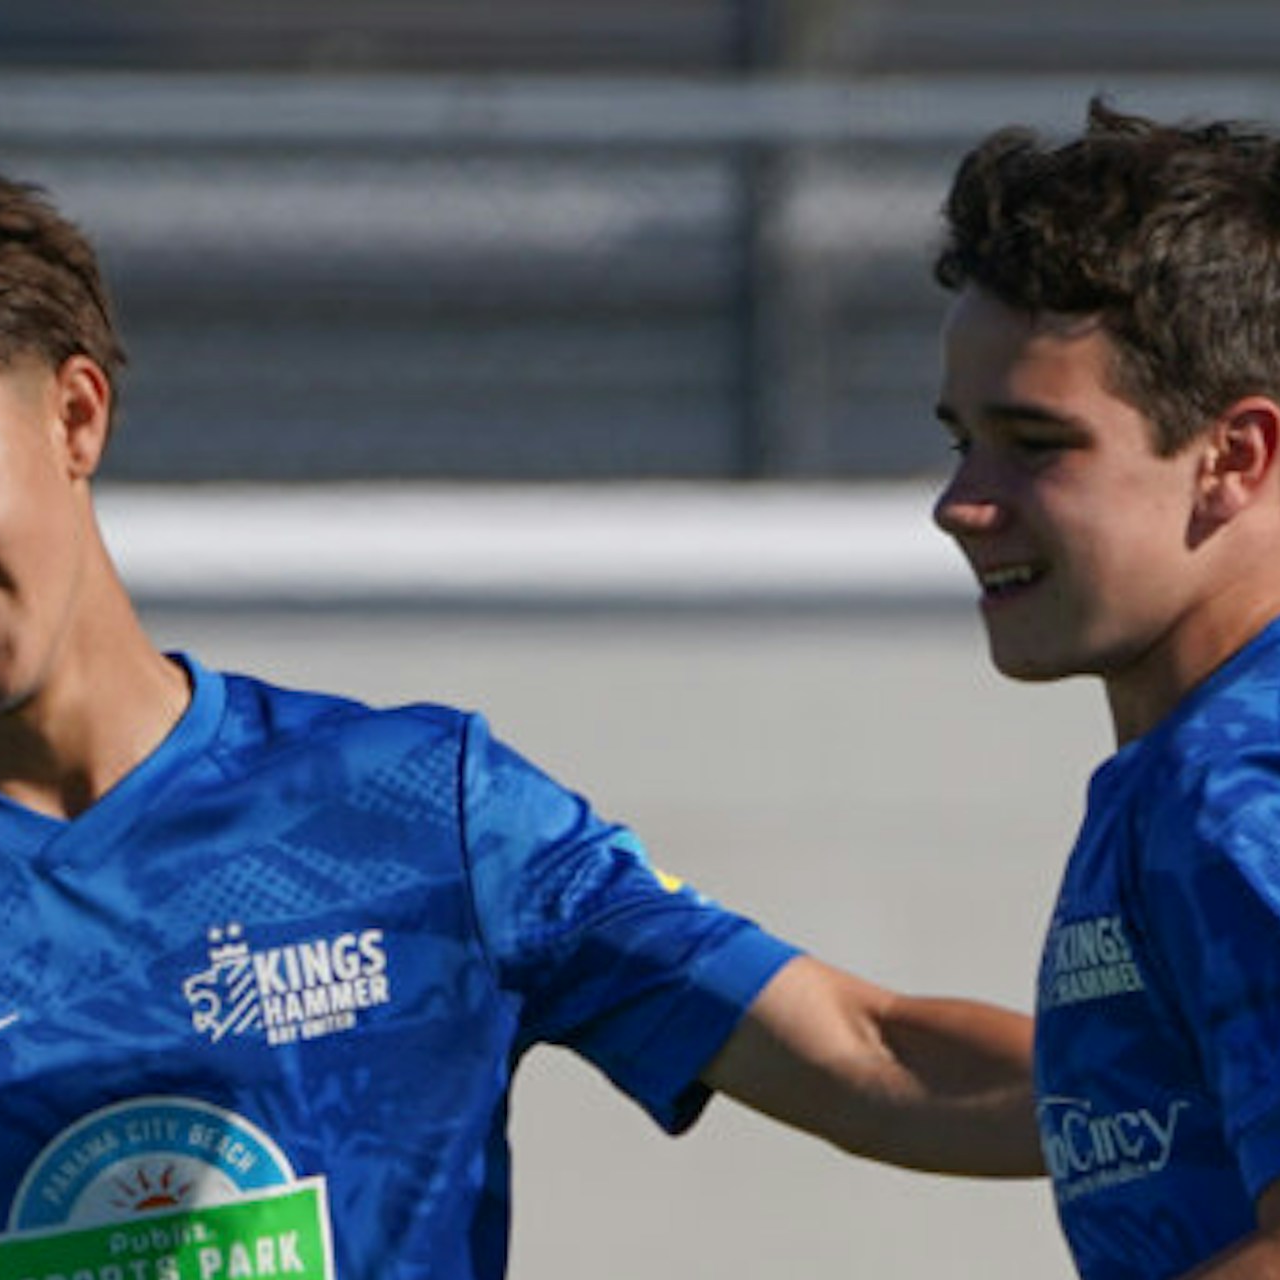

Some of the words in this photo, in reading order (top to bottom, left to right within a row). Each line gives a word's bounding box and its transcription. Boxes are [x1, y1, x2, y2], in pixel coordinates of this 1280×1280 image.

[253, 929, 387, 996] KINGS
[263, 975, 391, 1030] HAMMER
[42, 1131, 118, 1206] PANAMA
[124, 1116, 180, 1143] CITY
[188, 1121, 258, 1174] BEACH
